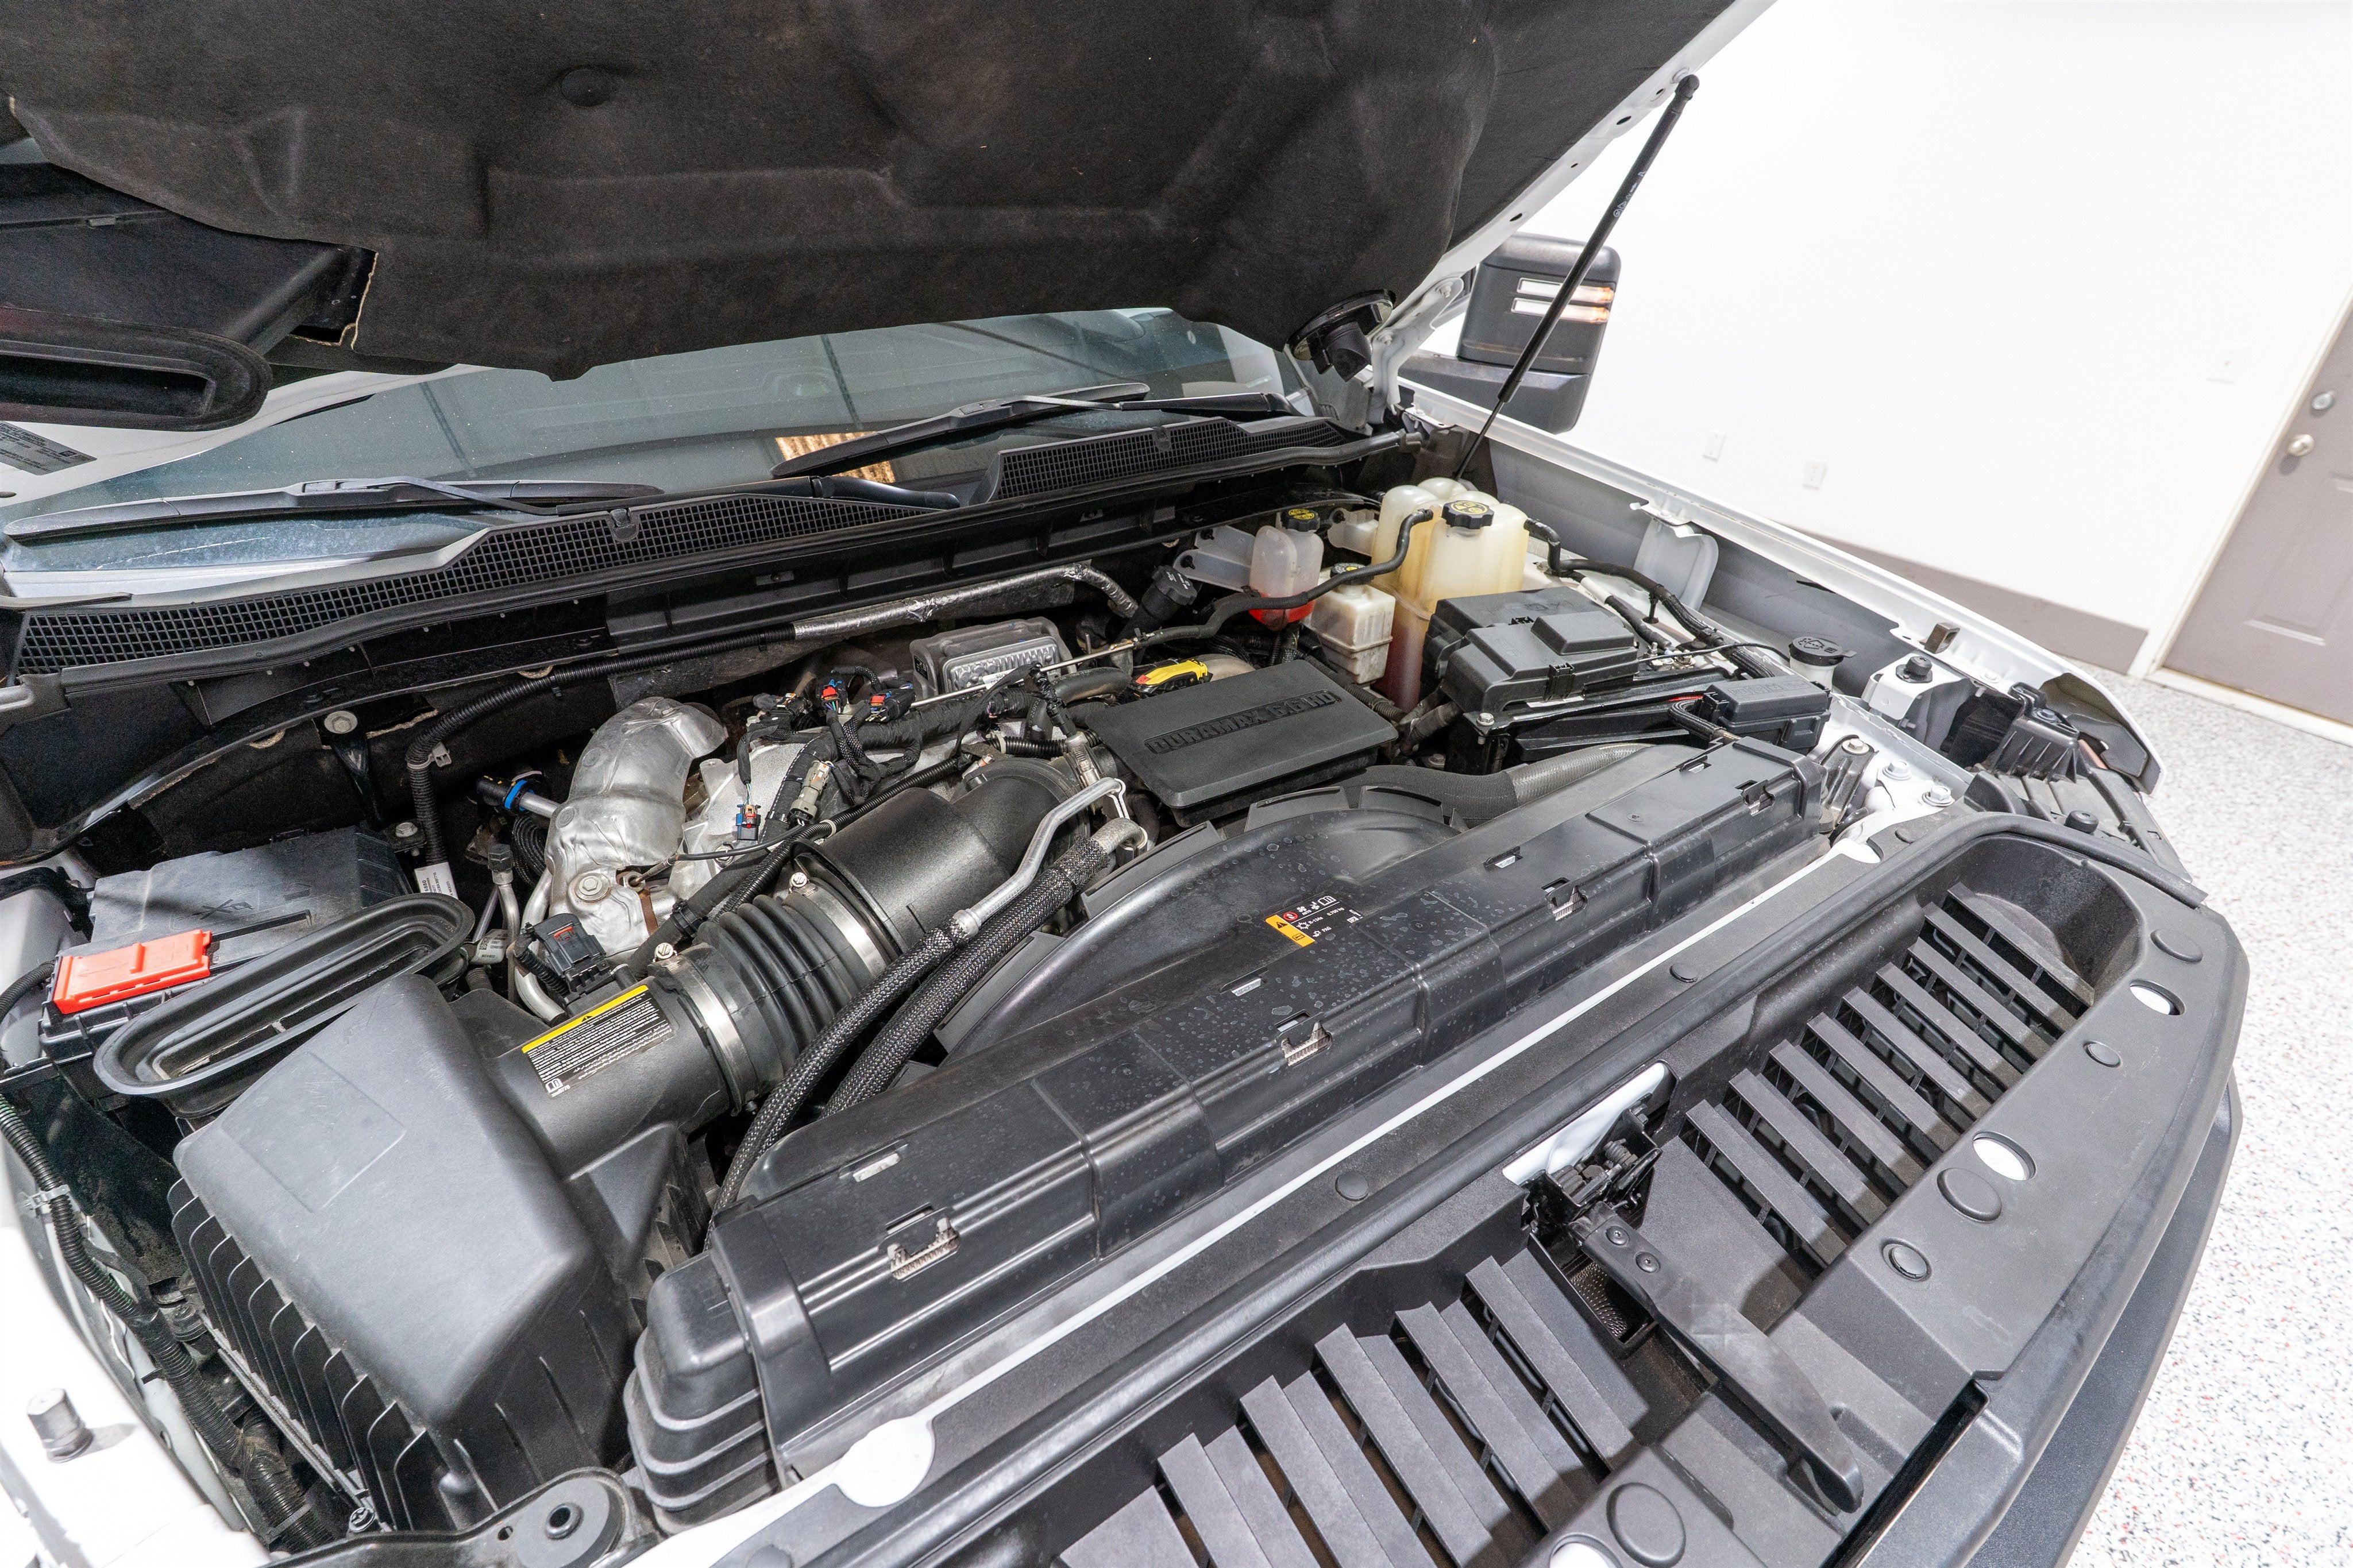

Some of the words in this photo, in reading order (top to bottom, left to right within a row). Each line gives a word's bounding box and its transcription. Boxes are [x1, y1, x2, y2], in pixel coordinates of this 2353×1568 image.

[1150, 710, 1267, 754] DURAMAX
[1269, 698, 1305, 718] 6.6
[1304, 691, 1337, 708] HD
